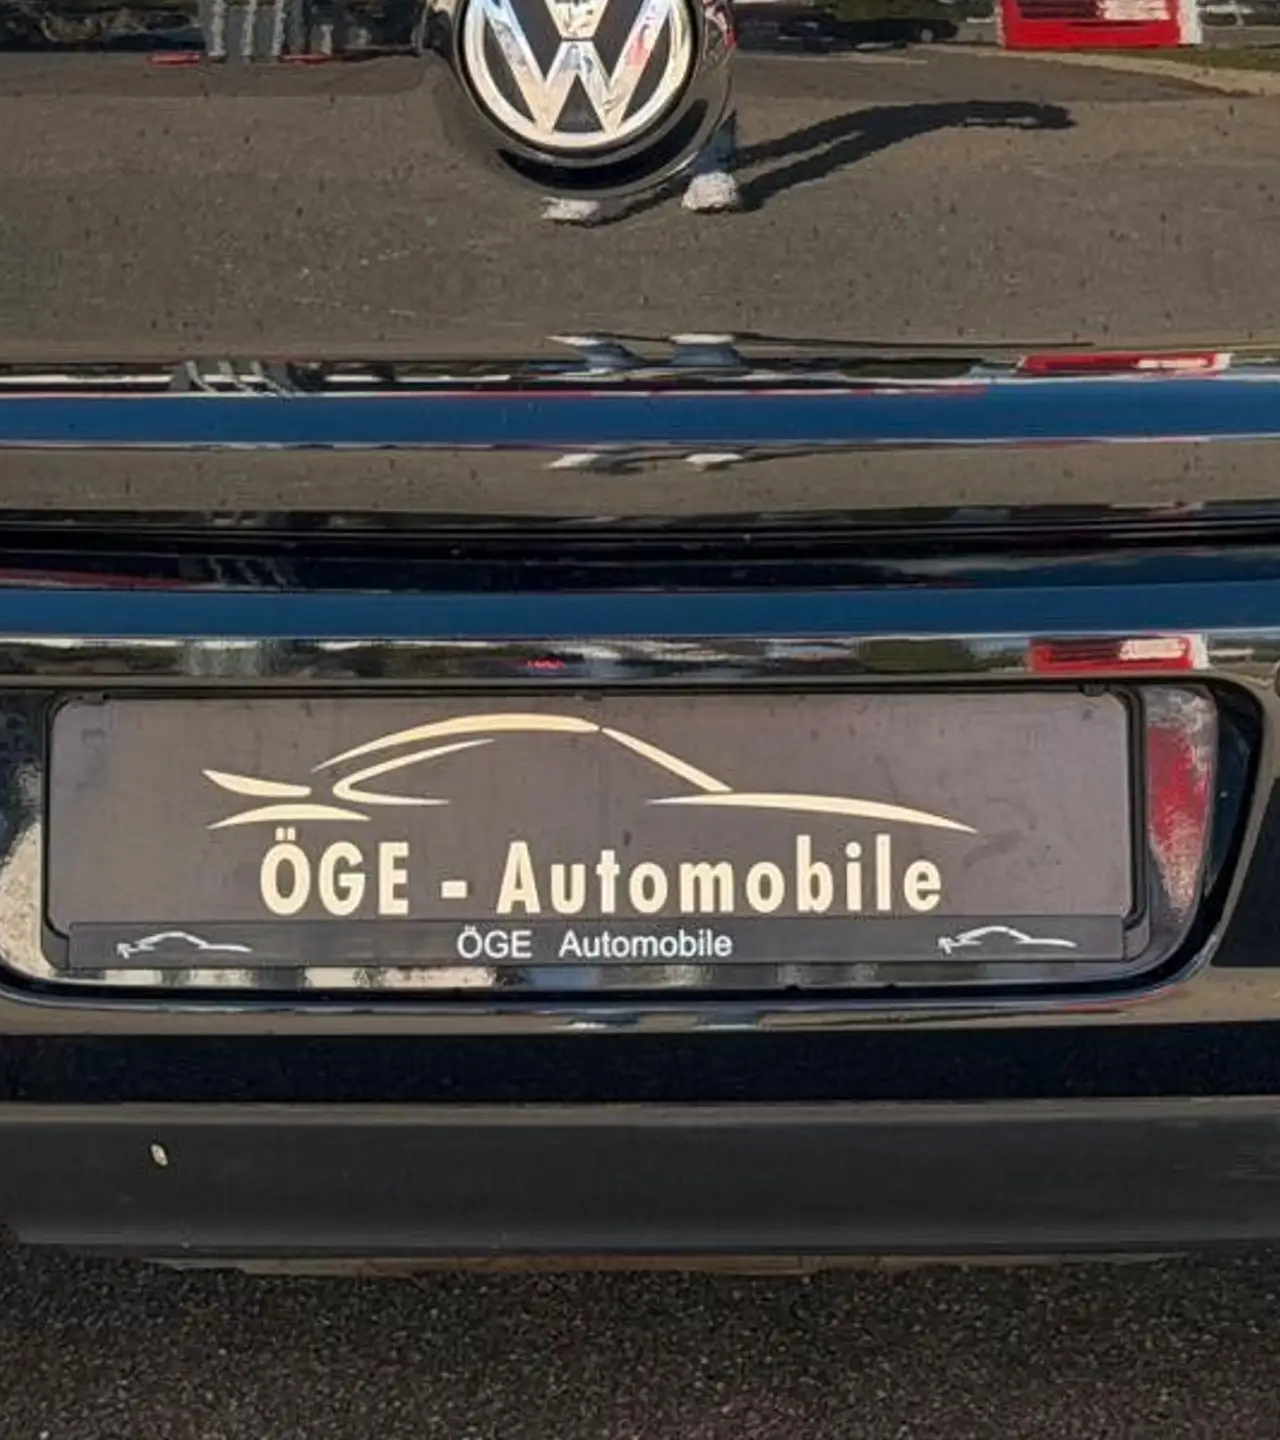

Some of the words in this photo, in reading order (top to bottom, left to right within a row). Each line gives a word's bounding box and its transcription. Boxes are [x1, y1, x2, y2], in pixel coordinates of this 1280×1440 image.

[260, 827, 409, 916] ÖGE
[495, 834, 942, 916] Automobile
[456, 926, 533, 959] ÖGE
[558, 928, 734, 958] Automobile
